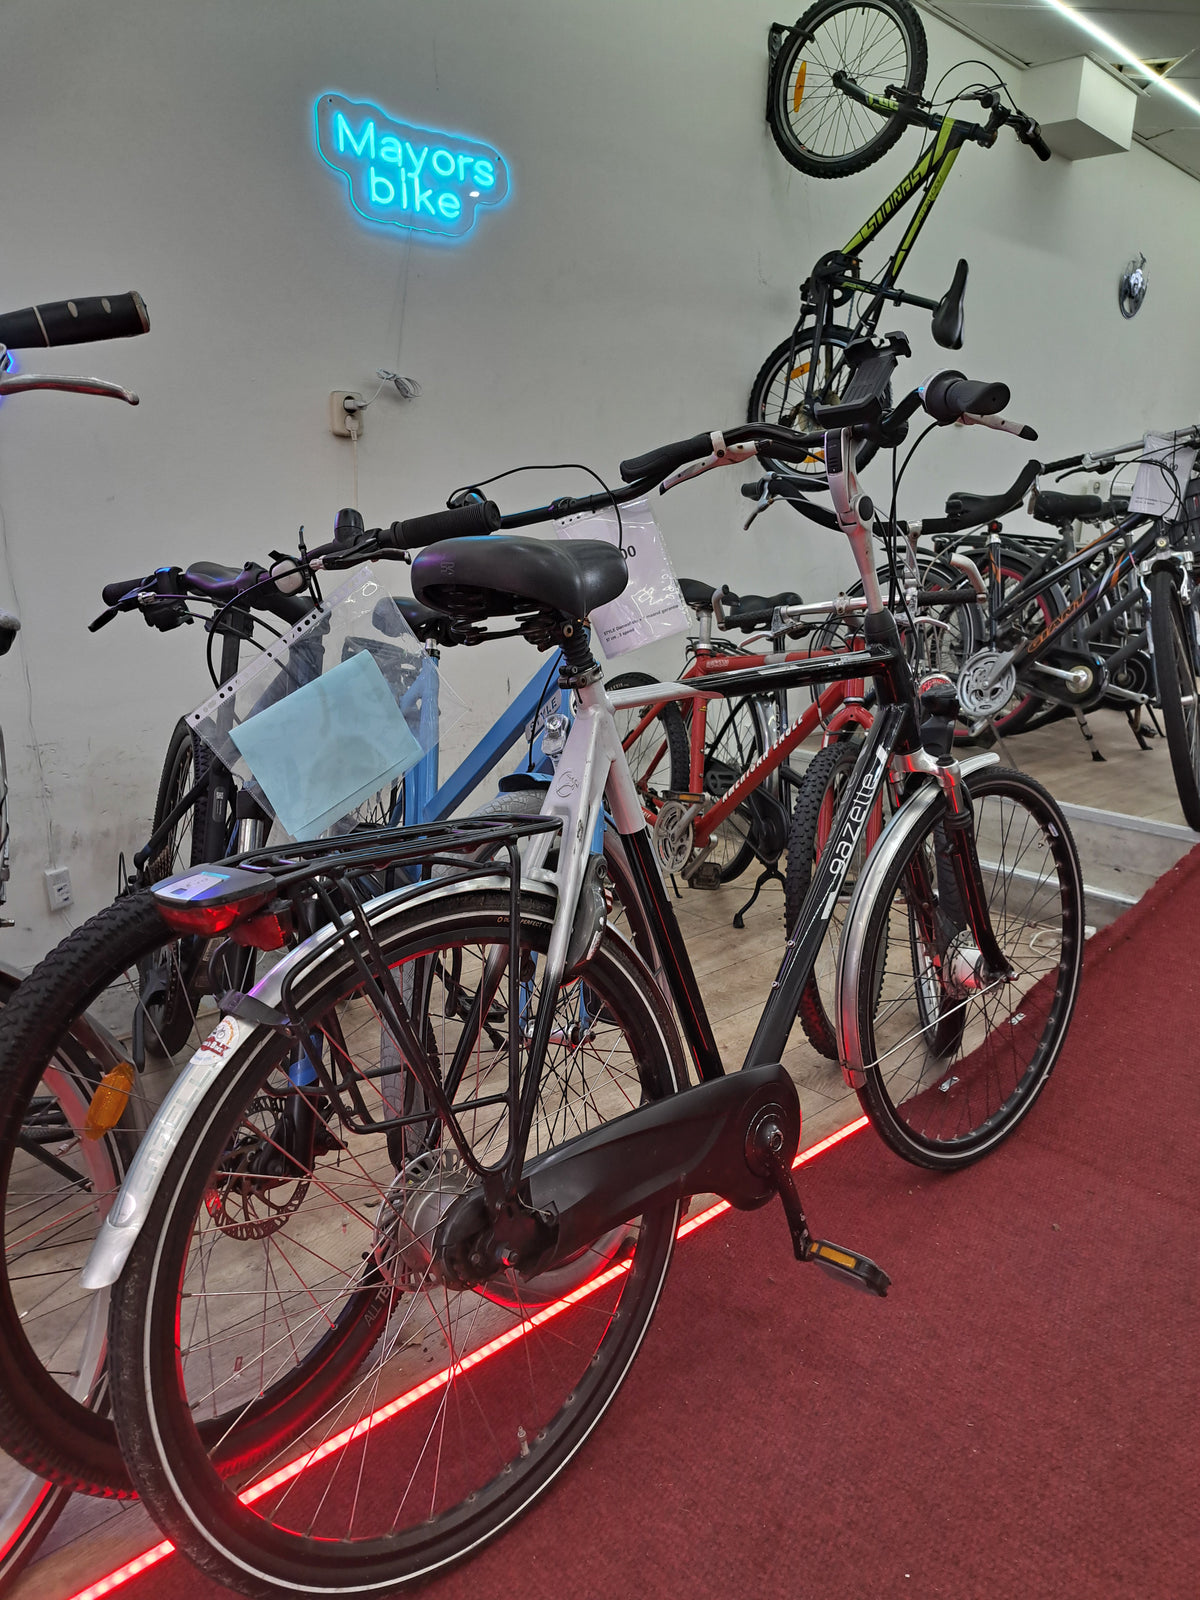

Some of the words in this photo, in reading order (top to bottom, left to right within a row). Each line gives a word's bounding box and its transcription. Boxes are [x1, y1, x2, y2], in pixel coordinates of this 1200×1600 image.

[336, 112, 496, 188] Mayors
[369, 166, 461, 219] bike
[1027, 589, 1088, 653] GIANT
[829, 773, 876, 876] gazelle
[364, 1305, 382, 1327] ALL
